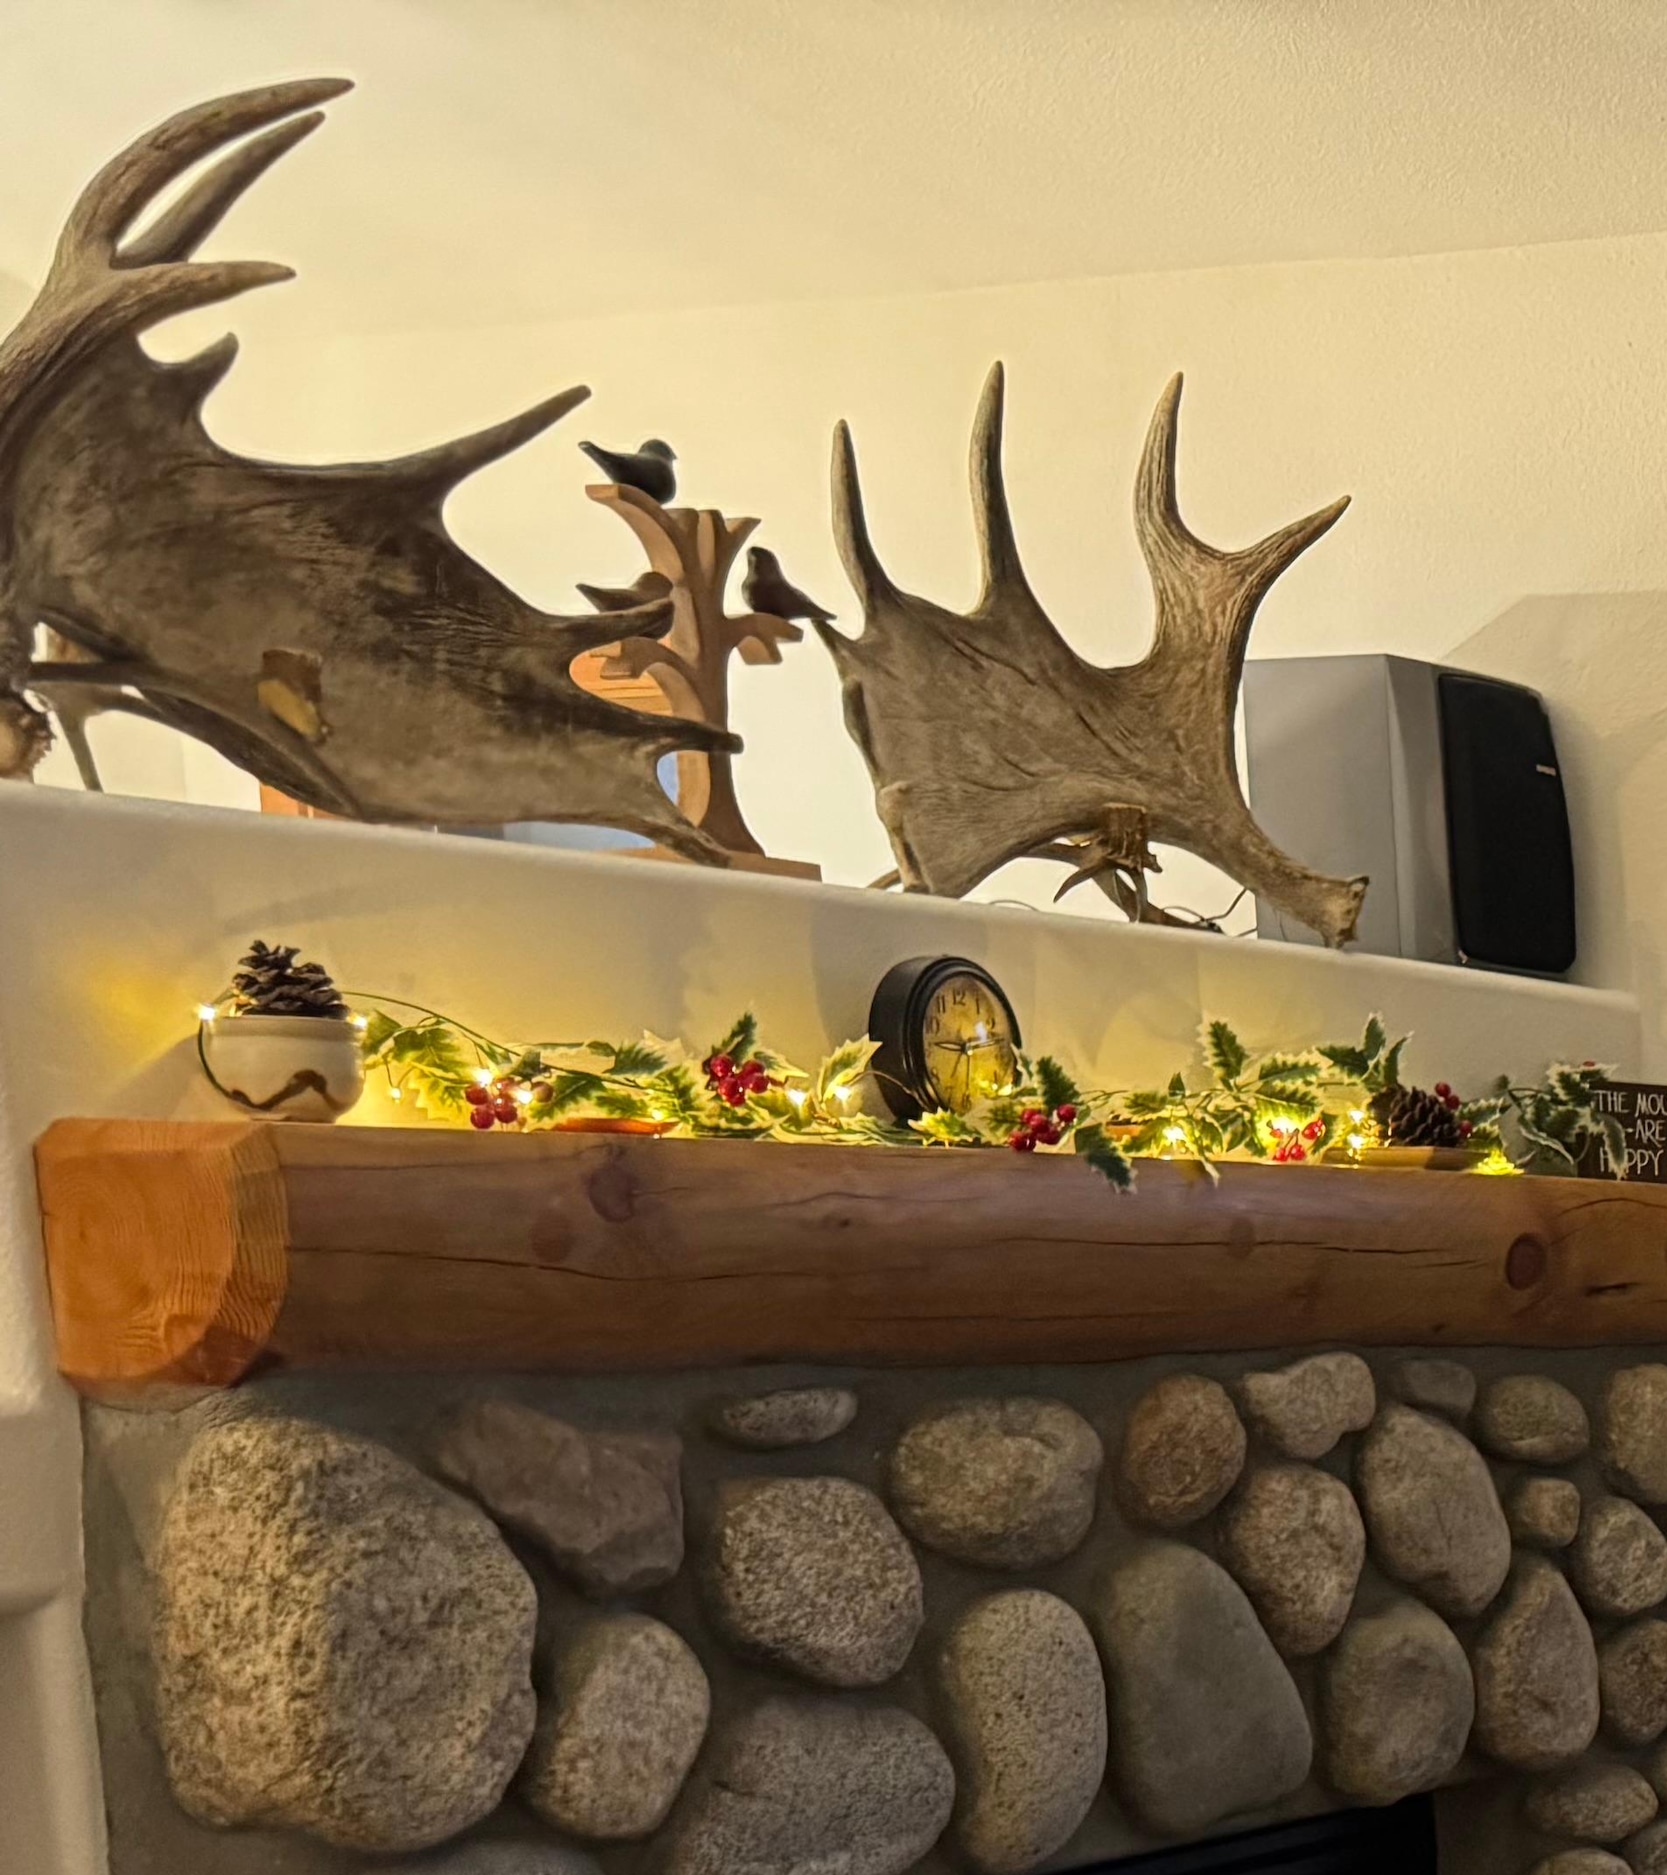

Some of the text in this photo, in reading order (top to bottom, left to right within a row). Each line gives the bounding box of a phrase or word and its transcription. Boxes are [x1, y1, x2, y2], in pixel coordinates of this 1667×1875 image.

[953, 987, 966, 1006] 12
[1593, 1089, 1630, 1114] THE
[1635, 1118, 1667, 1148] ARE
[1600, 1147, 1665, 1176] HPPY
